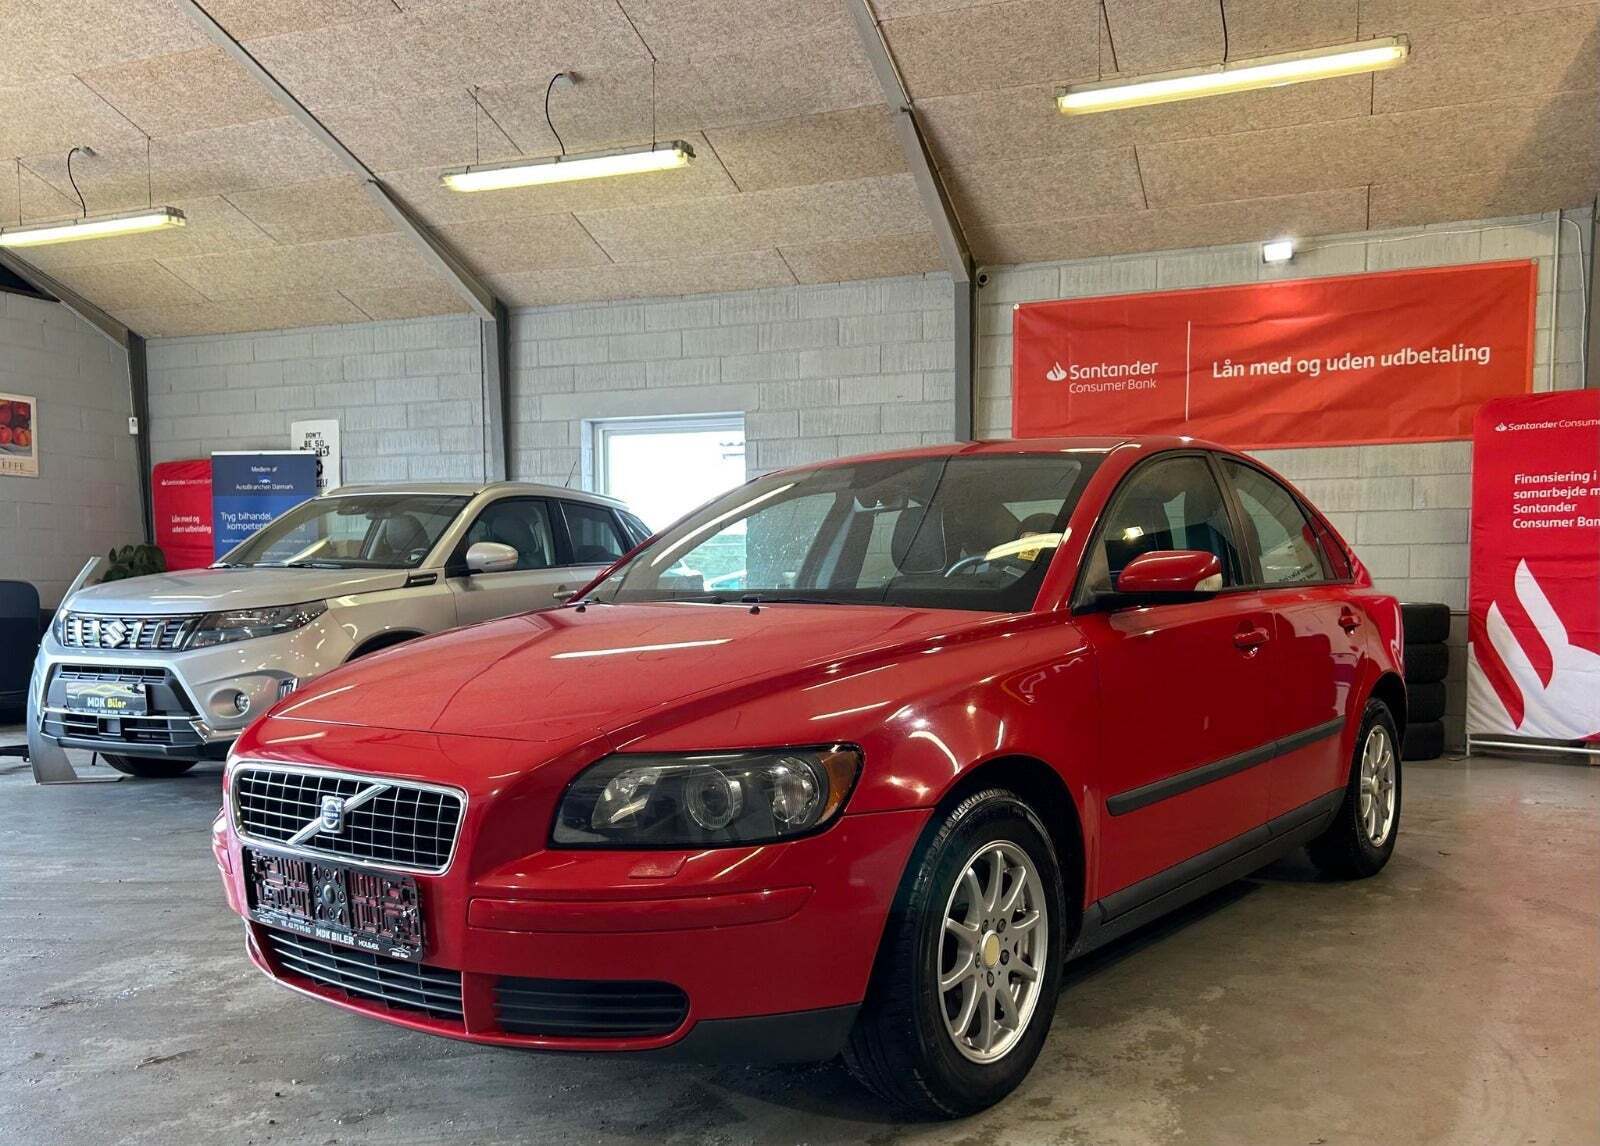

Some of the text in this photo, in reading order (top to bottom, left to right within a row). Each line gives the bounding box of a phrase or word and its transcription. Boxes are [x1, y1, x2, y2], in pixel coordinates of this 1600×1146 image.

[1213, 343, 1490, 378] Lån med og uden udbetaling
[1070, 361, 1159, 380] Santander
[1069, 379, 1157, 394] Consumer Bank
[1508, 421, 1558, 431] Santander
[314, 439, 325, 447] SO
[1514, 470, 1597, 485] Finansiering i
[1513, 486, 1587, 499] samarbejde
[1513, 502, 1577, 514] Santander
[220, 512, 236, 523] Tryg
[1513, 518, 1575, 529] Consumer
[315, 928, 330, 939] MDK
[331, 931, 354, 946] BILER
